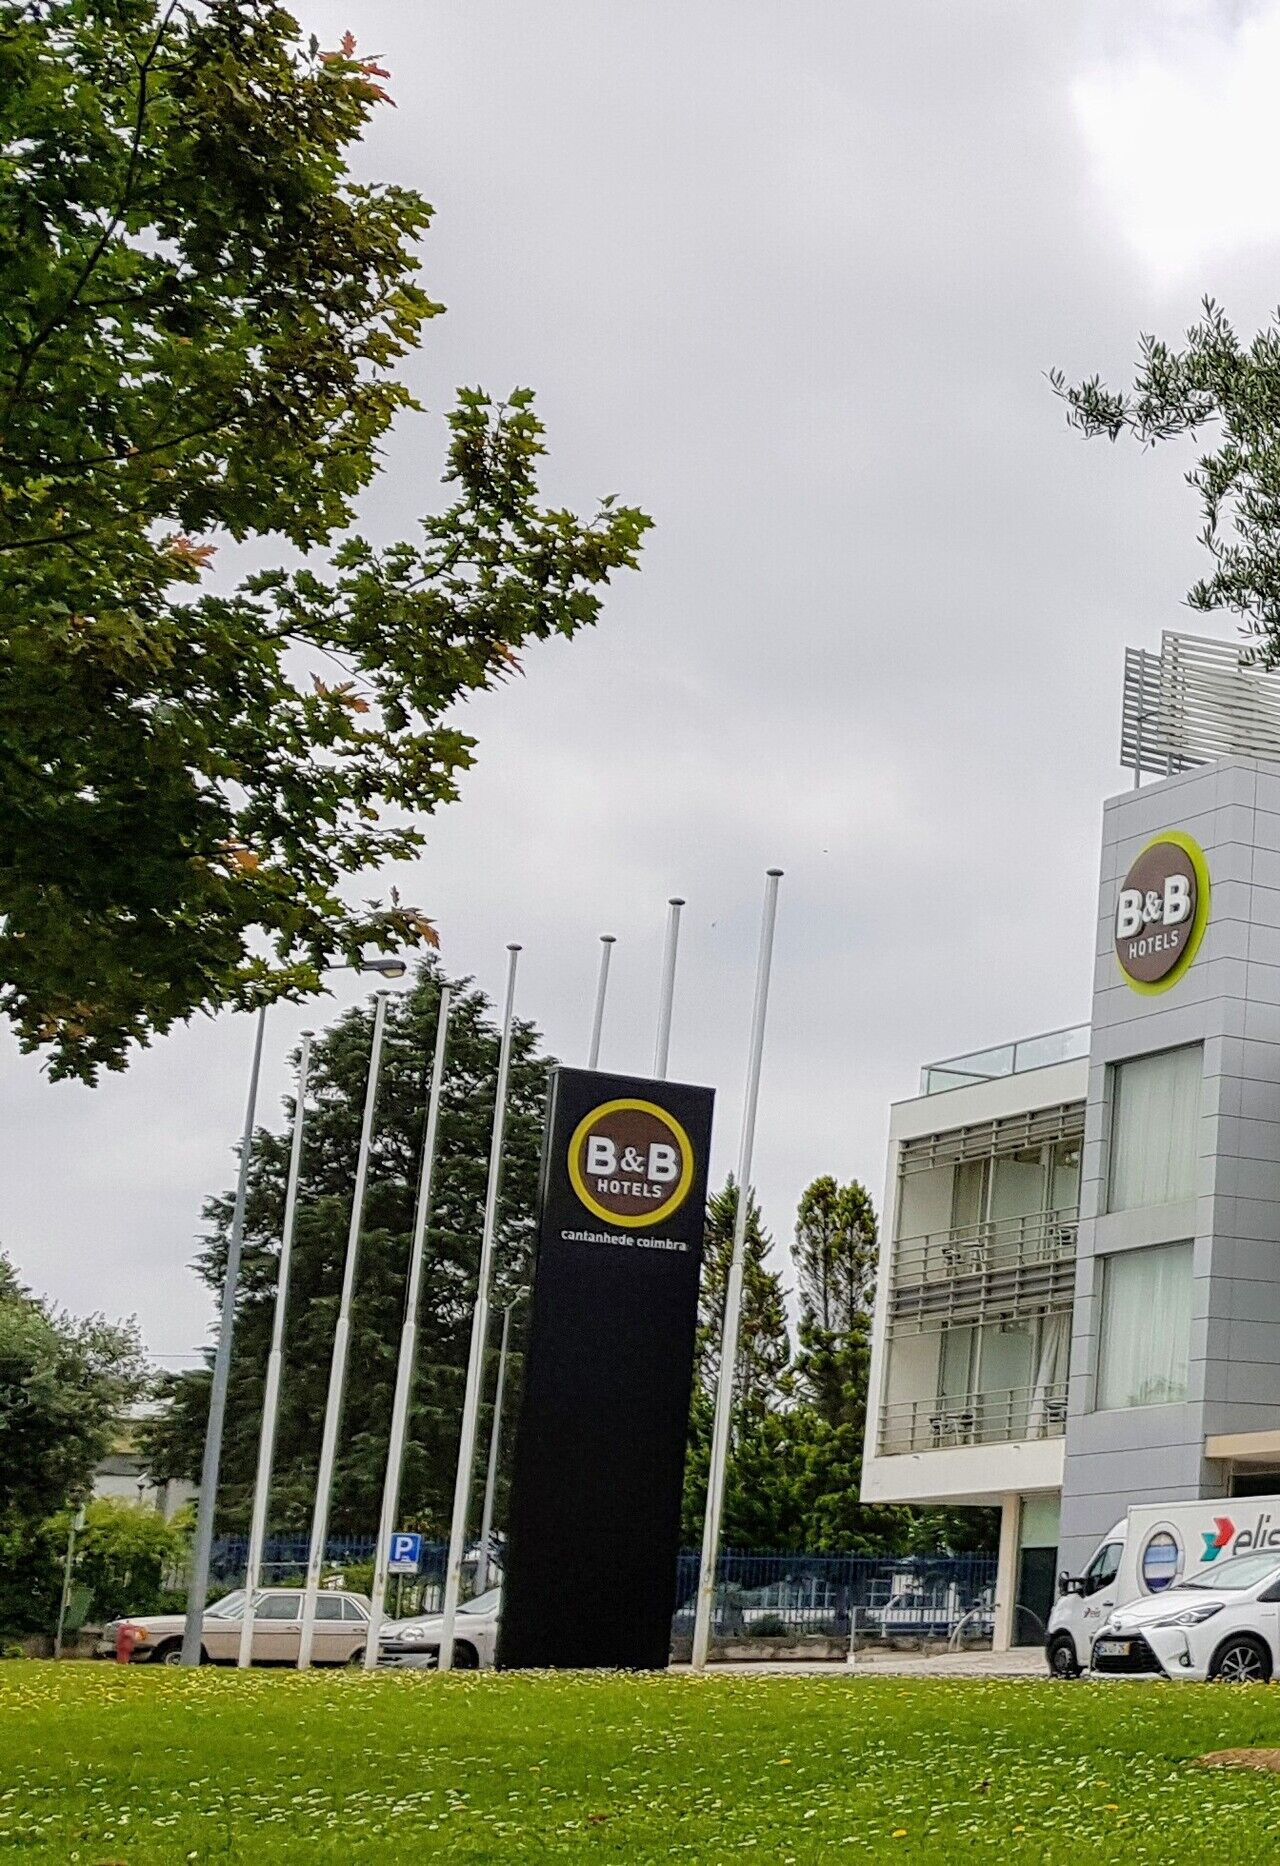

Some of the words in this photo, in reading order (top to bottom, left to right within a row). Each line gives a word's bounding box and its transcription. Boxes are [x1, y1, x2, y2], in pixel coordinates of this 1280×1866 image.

[1116, 874, 1191, 939] B&B
[1129, 930, 1179, 959] HOTELS
[587, 1135, 678, 1182] B&B
[597, 1179, 662, 1198] HOTELS
[561, 1229, 635, 1247] cantanhede
[637, 1237, 687, 1252] coimbra
[395, 1537, 413, 1559] P
